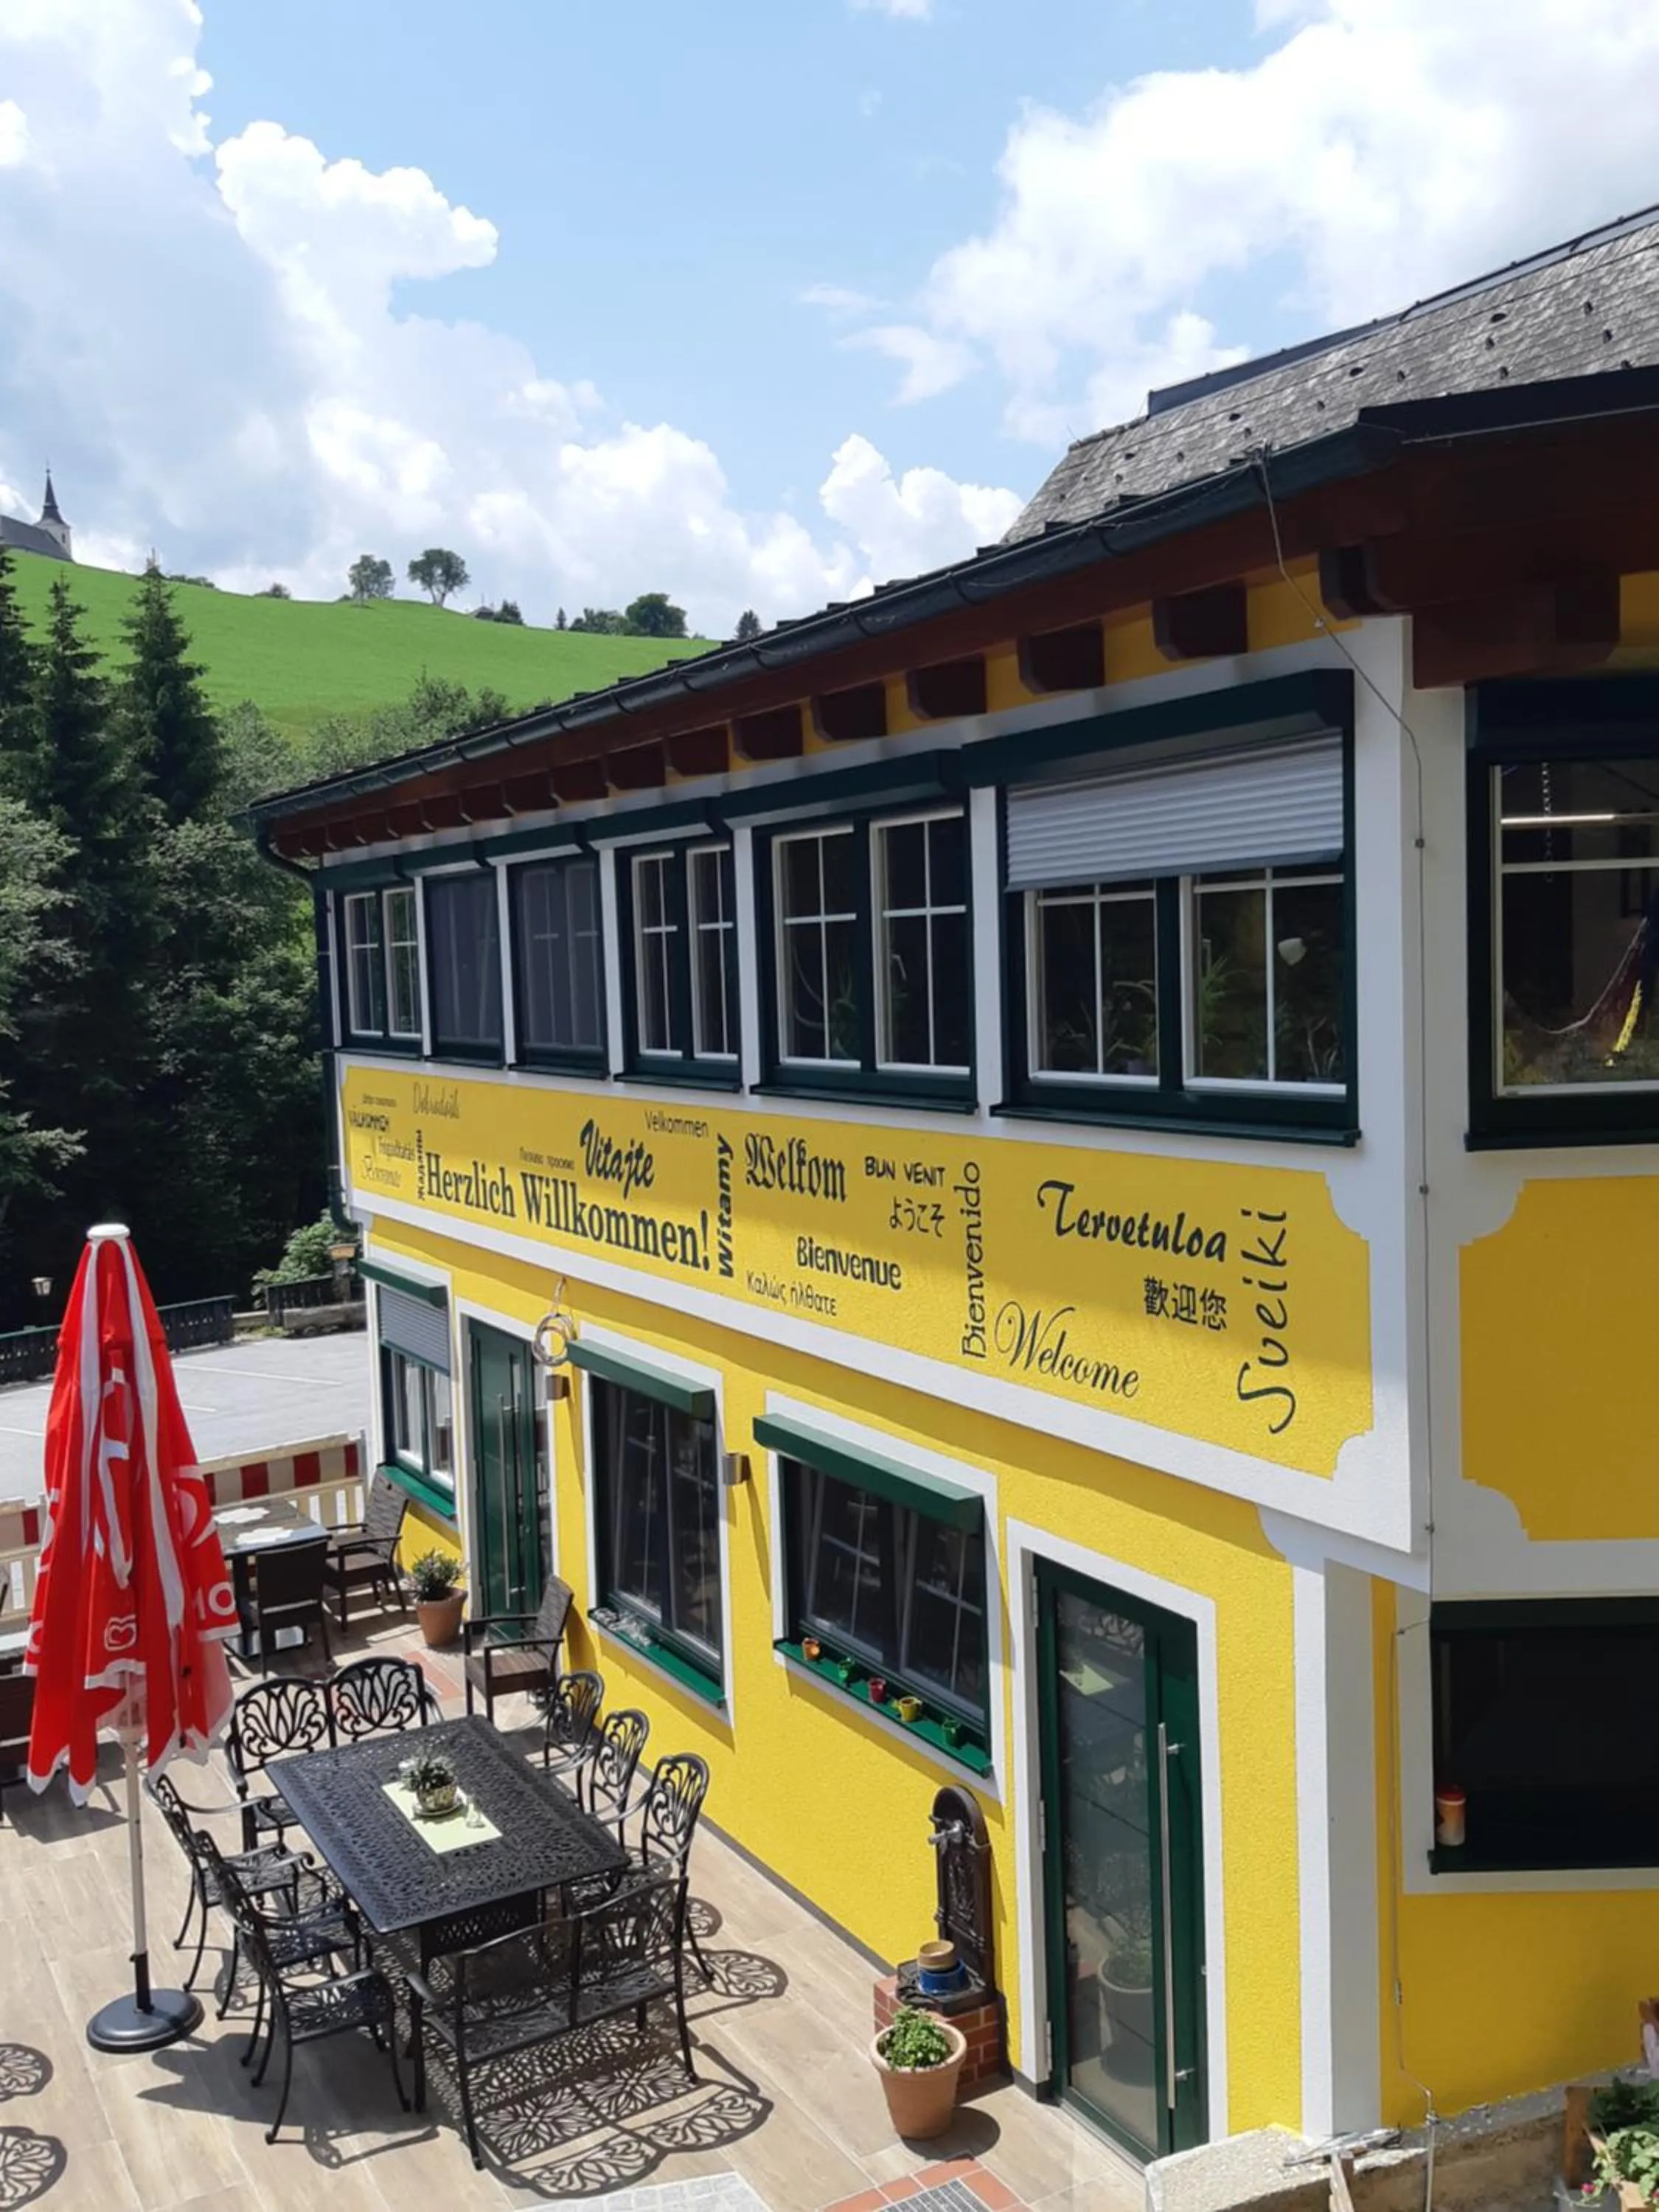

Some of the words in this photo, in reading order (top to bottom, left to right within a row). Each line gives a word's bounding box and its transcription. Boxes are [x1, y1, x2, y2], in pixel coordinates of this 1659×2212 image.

[580, 1118, 655, 1199] Vitajte
[644, 1110, 709, 1138] Velkommen
[717, 1133, 734, 1279] Witamy
[745, 1132, 847, 1203] Welkom
[864, 1155, 896, 1180] BUN
[903, 1162, 946, 1187] VENIT
[425, 1152, 517, 1218] Herzlich
[520, 1172, 711, 1271] Willkommen!
[888, 1196, 945, 1238] ようこそ
[1037, 1180, 1227, 1262] Tervetuloa
[796, 1235, 902, 1290] Bienvenue
[953, 1161, 987, 1359] Bienvenido
[1143, 1275, 1228, 1332] 歡迎您
[1237, 1208, 1296, 1434] Sveiki
[994, 1301, 1140, 1399] Welcome
